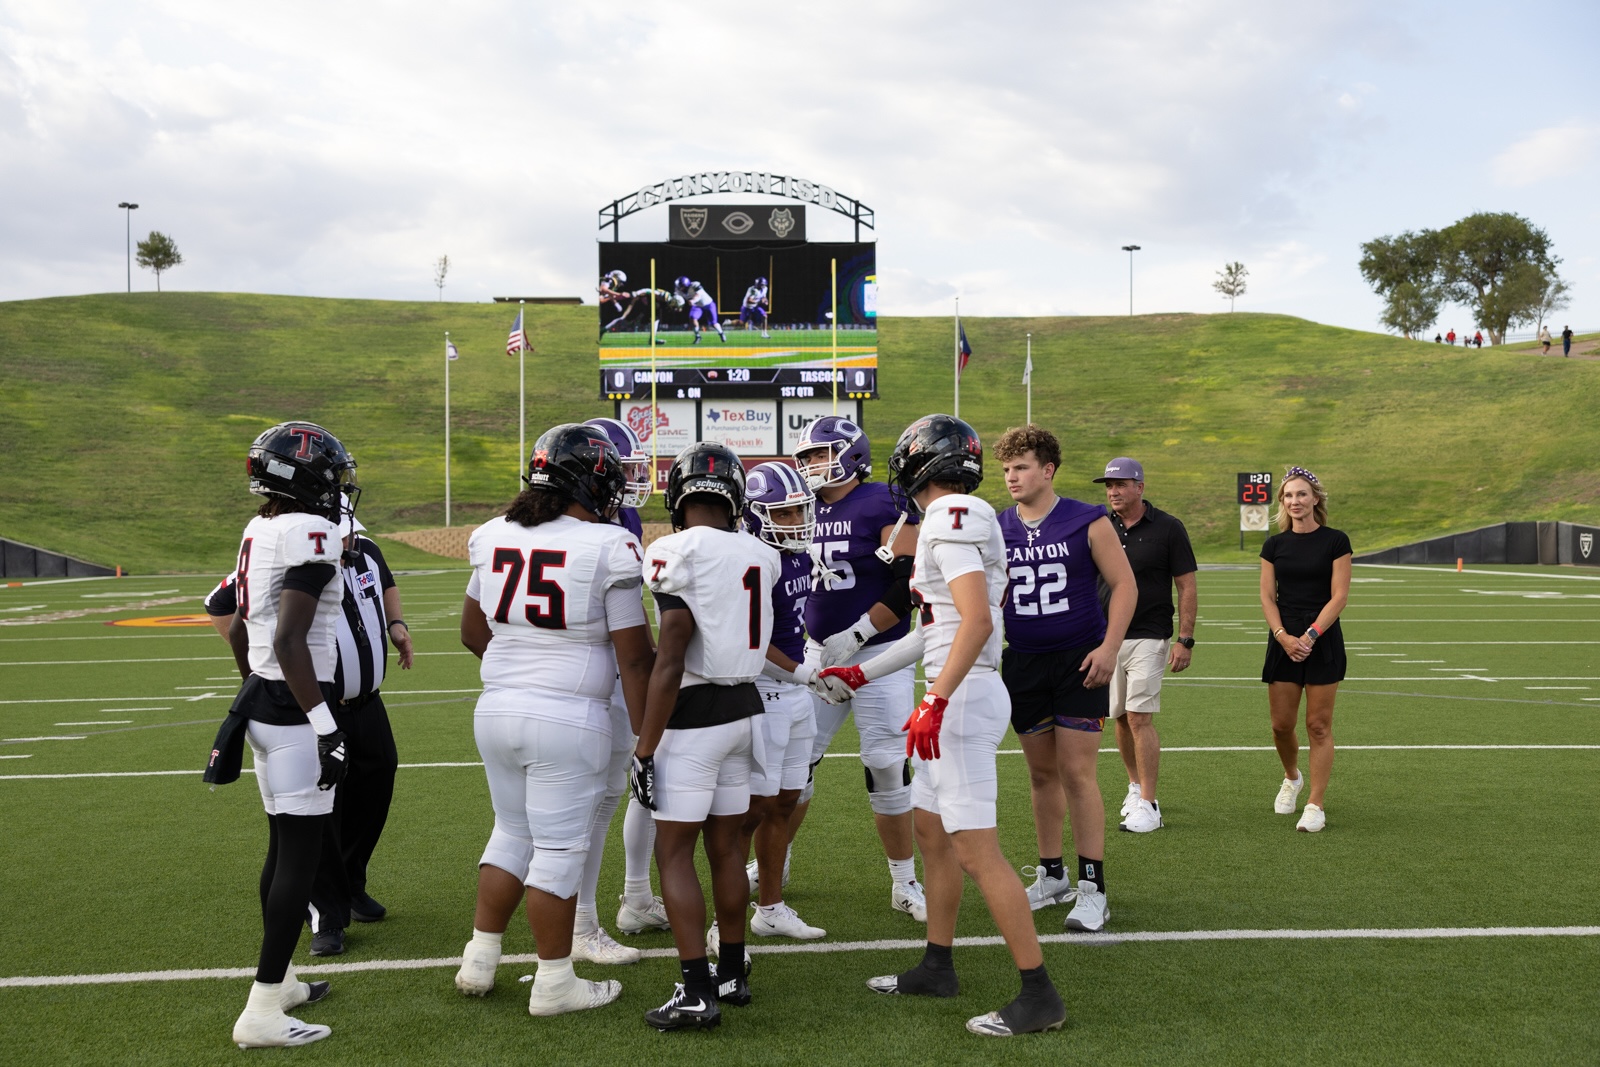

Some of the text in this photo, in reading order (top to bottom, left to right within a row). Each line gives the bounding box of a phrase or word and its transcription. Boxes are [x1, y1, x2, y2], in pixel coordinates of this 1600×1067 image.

[636, 171, 838, 210] CANYON ISD
[614, 371, 625, 388] 0
[726, 368, 751, 382] 1:20
[854, 370, 865, 387] 0
[677, 387, 702, 398] & ON
[781, 387, 814, 397] 1ST QTR
[722, 409, 772, 424] TexBuy
[291, 428, 324, 462] T
[726, 438, 755, 448] Region
[588, 437, 613, 476] T
[708, 456, 715, 473] 1
[695, 479, 725, 490] schutt
[1250, 473, 1271, 484] 1:20
[1242, 483, 1268, 502] 25
[948, 507, 969, 530] T
[308, 532, 328, 555] T
[625, 542, 643, 562] T
[651, 559, 668, 582] T
[491, 547, 568, 630] 75
[1009, 562, 1070, 616] 22
[742, 566, 762, 650] 1
[719, 979, 737, 998] NIKE
